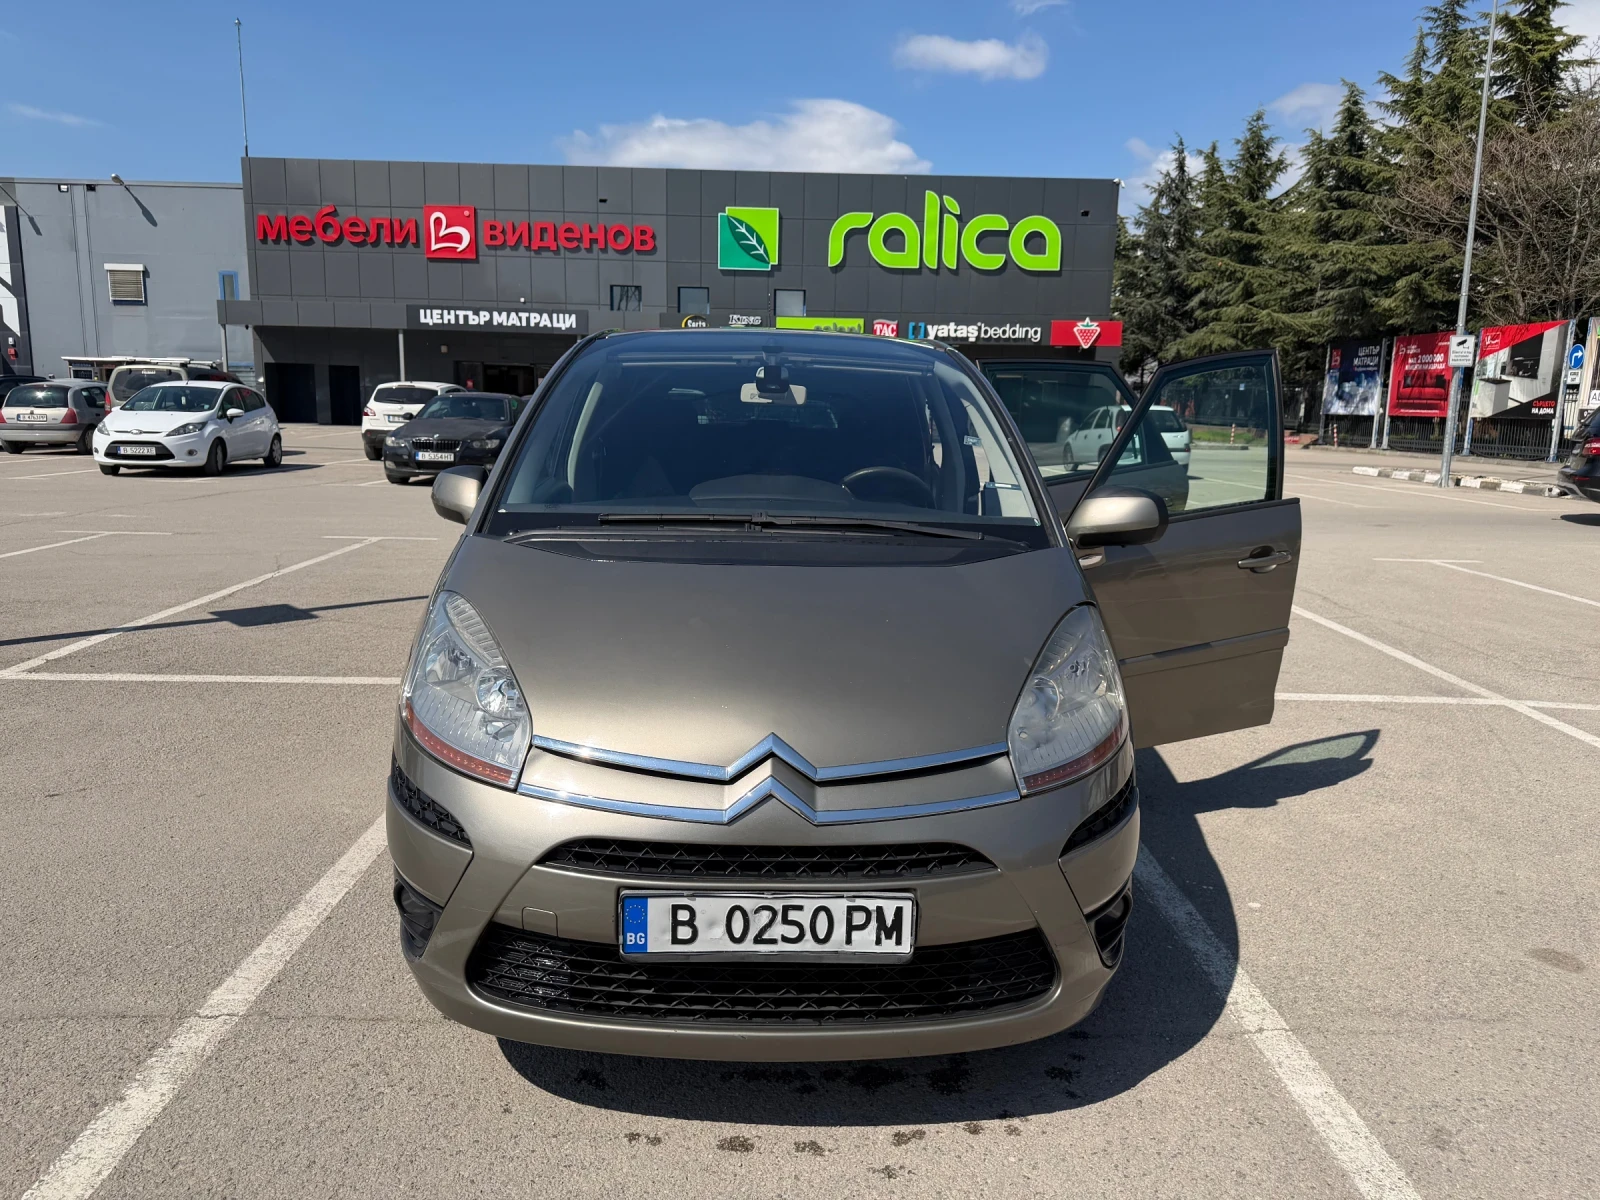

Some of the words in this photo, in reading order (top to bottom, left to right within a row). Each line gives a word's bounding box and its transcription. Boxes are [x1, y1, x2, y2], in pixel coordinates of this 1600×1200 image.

[256, 204, 418, 244] мебели
[482, 219, 657, 252] виденов
[828, 189, 1062, 271] ralica
[419, 308, 490, 327] ЦЕНТЪР
[492, 310, 577, 331] МАТРАЦИ
[1353, 355, 1379, 366] МАТРАЦИ
[1357, 345, 1380, 357] ЦЕНТЪР
[670, 903, 698, 945] B
[725, 904, 834, 945] 0250
[844, 905, 904, 947] PM
[626, 931, 646, 945] BG
